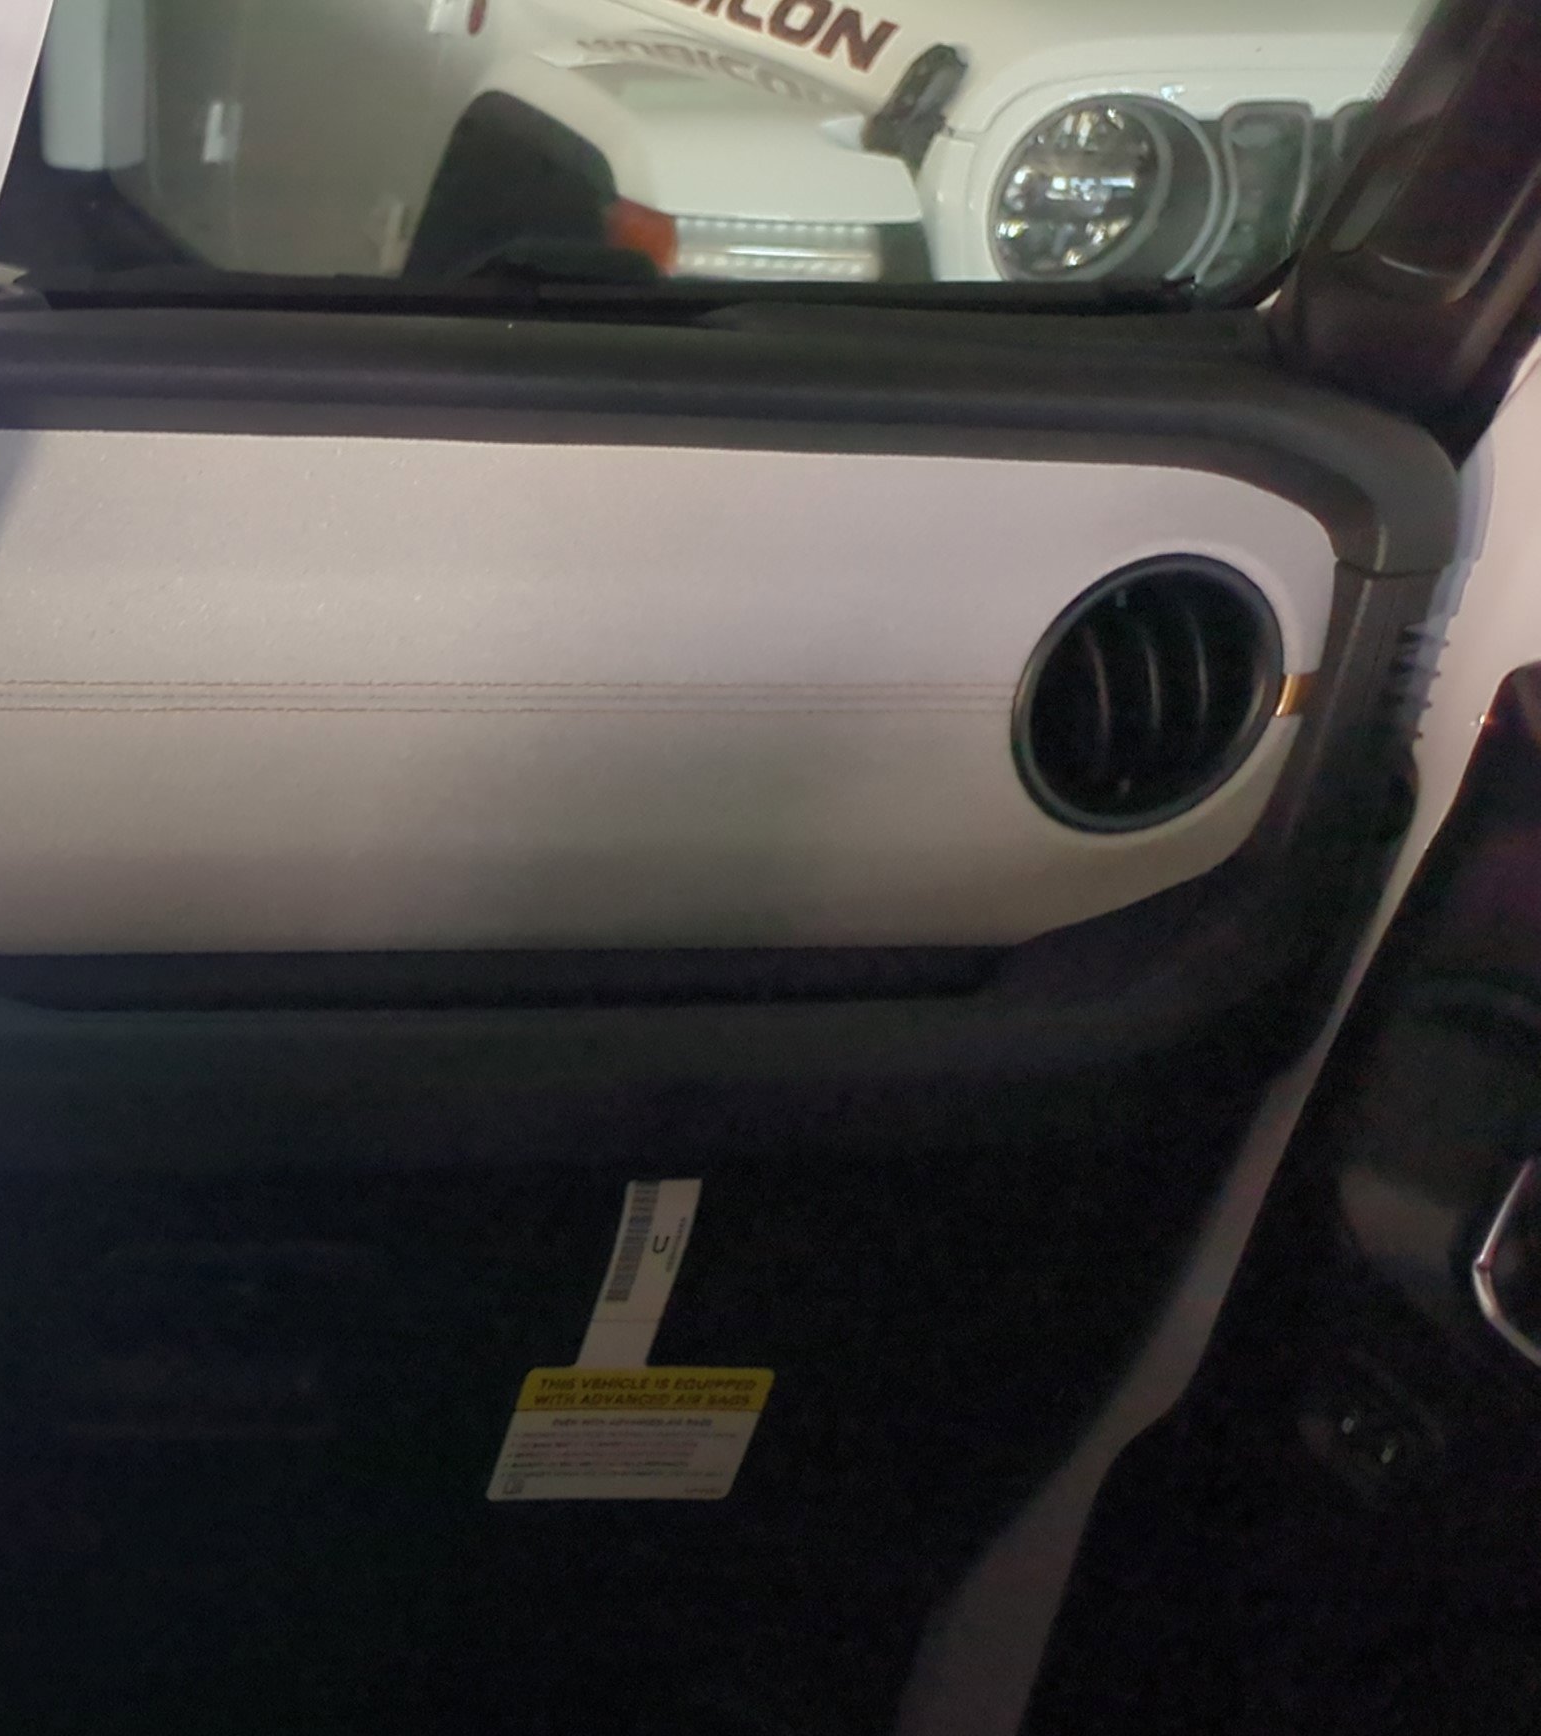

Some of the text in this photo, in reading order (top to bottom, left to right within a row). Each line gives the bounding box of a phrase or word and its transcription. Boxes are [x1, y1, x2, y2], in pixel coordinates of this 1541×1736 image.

[652, 1235, 670, 1254] U
[540, 1378, 757, 1391] THIS VEHICLE IS EQUIPPED
[533, 1393, 577, 1406] WITH
[579, 1394, 670, 1407] ADVANCED
